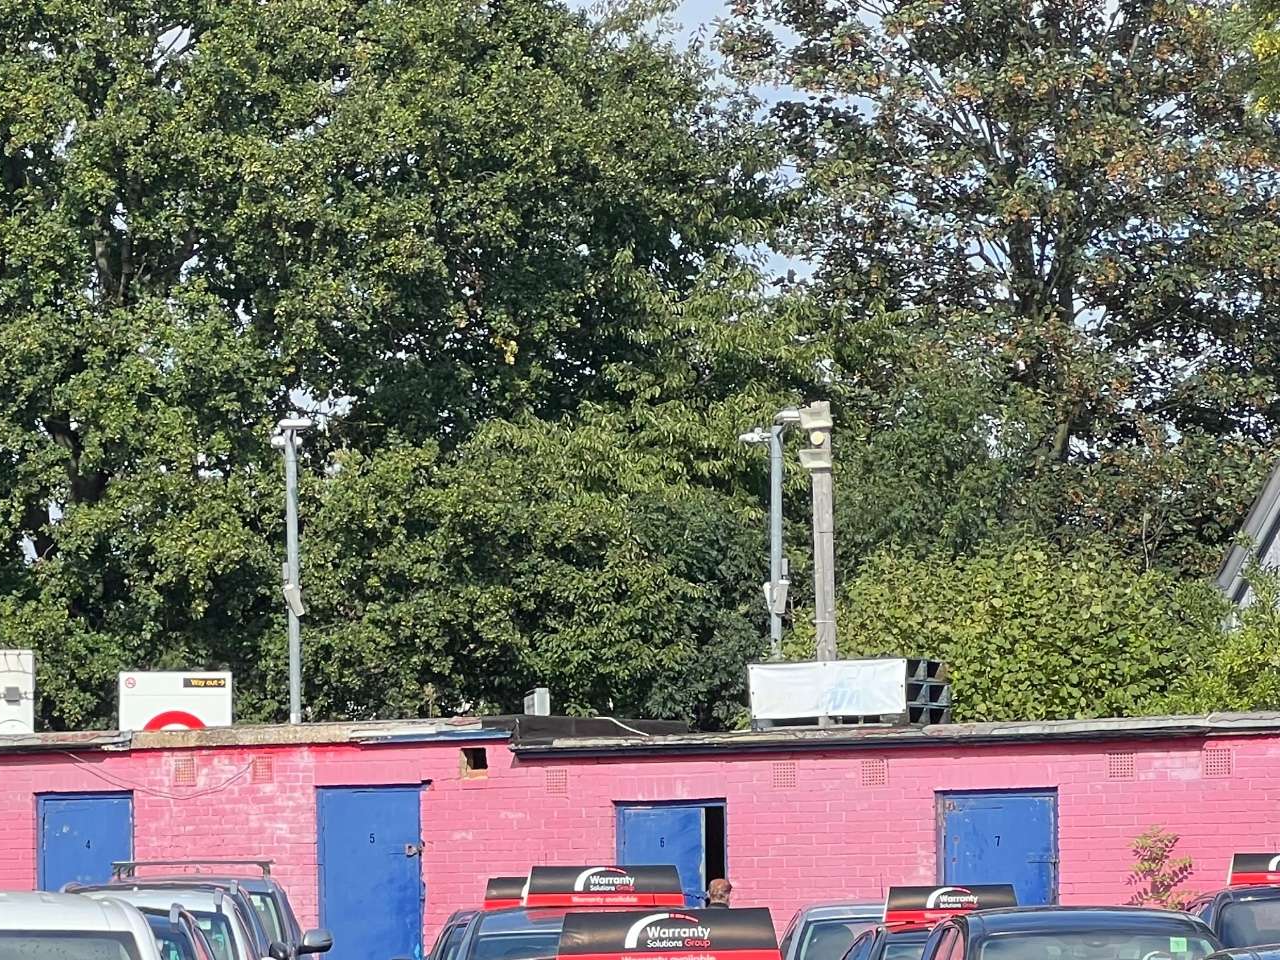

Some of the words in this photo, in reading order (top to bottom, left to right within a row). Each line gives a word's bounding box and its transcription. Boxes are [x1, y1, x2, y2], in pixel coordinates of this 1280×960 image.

[190, 679, 204, 687] Way
[589, 875, 634, 886] Warranty
[940, 894, 978, 904] Warranty
[646, 926, 710, 940] Warranty
[646, 939, 682, 948] Solutions
[684, 939, 711, 948] Group
